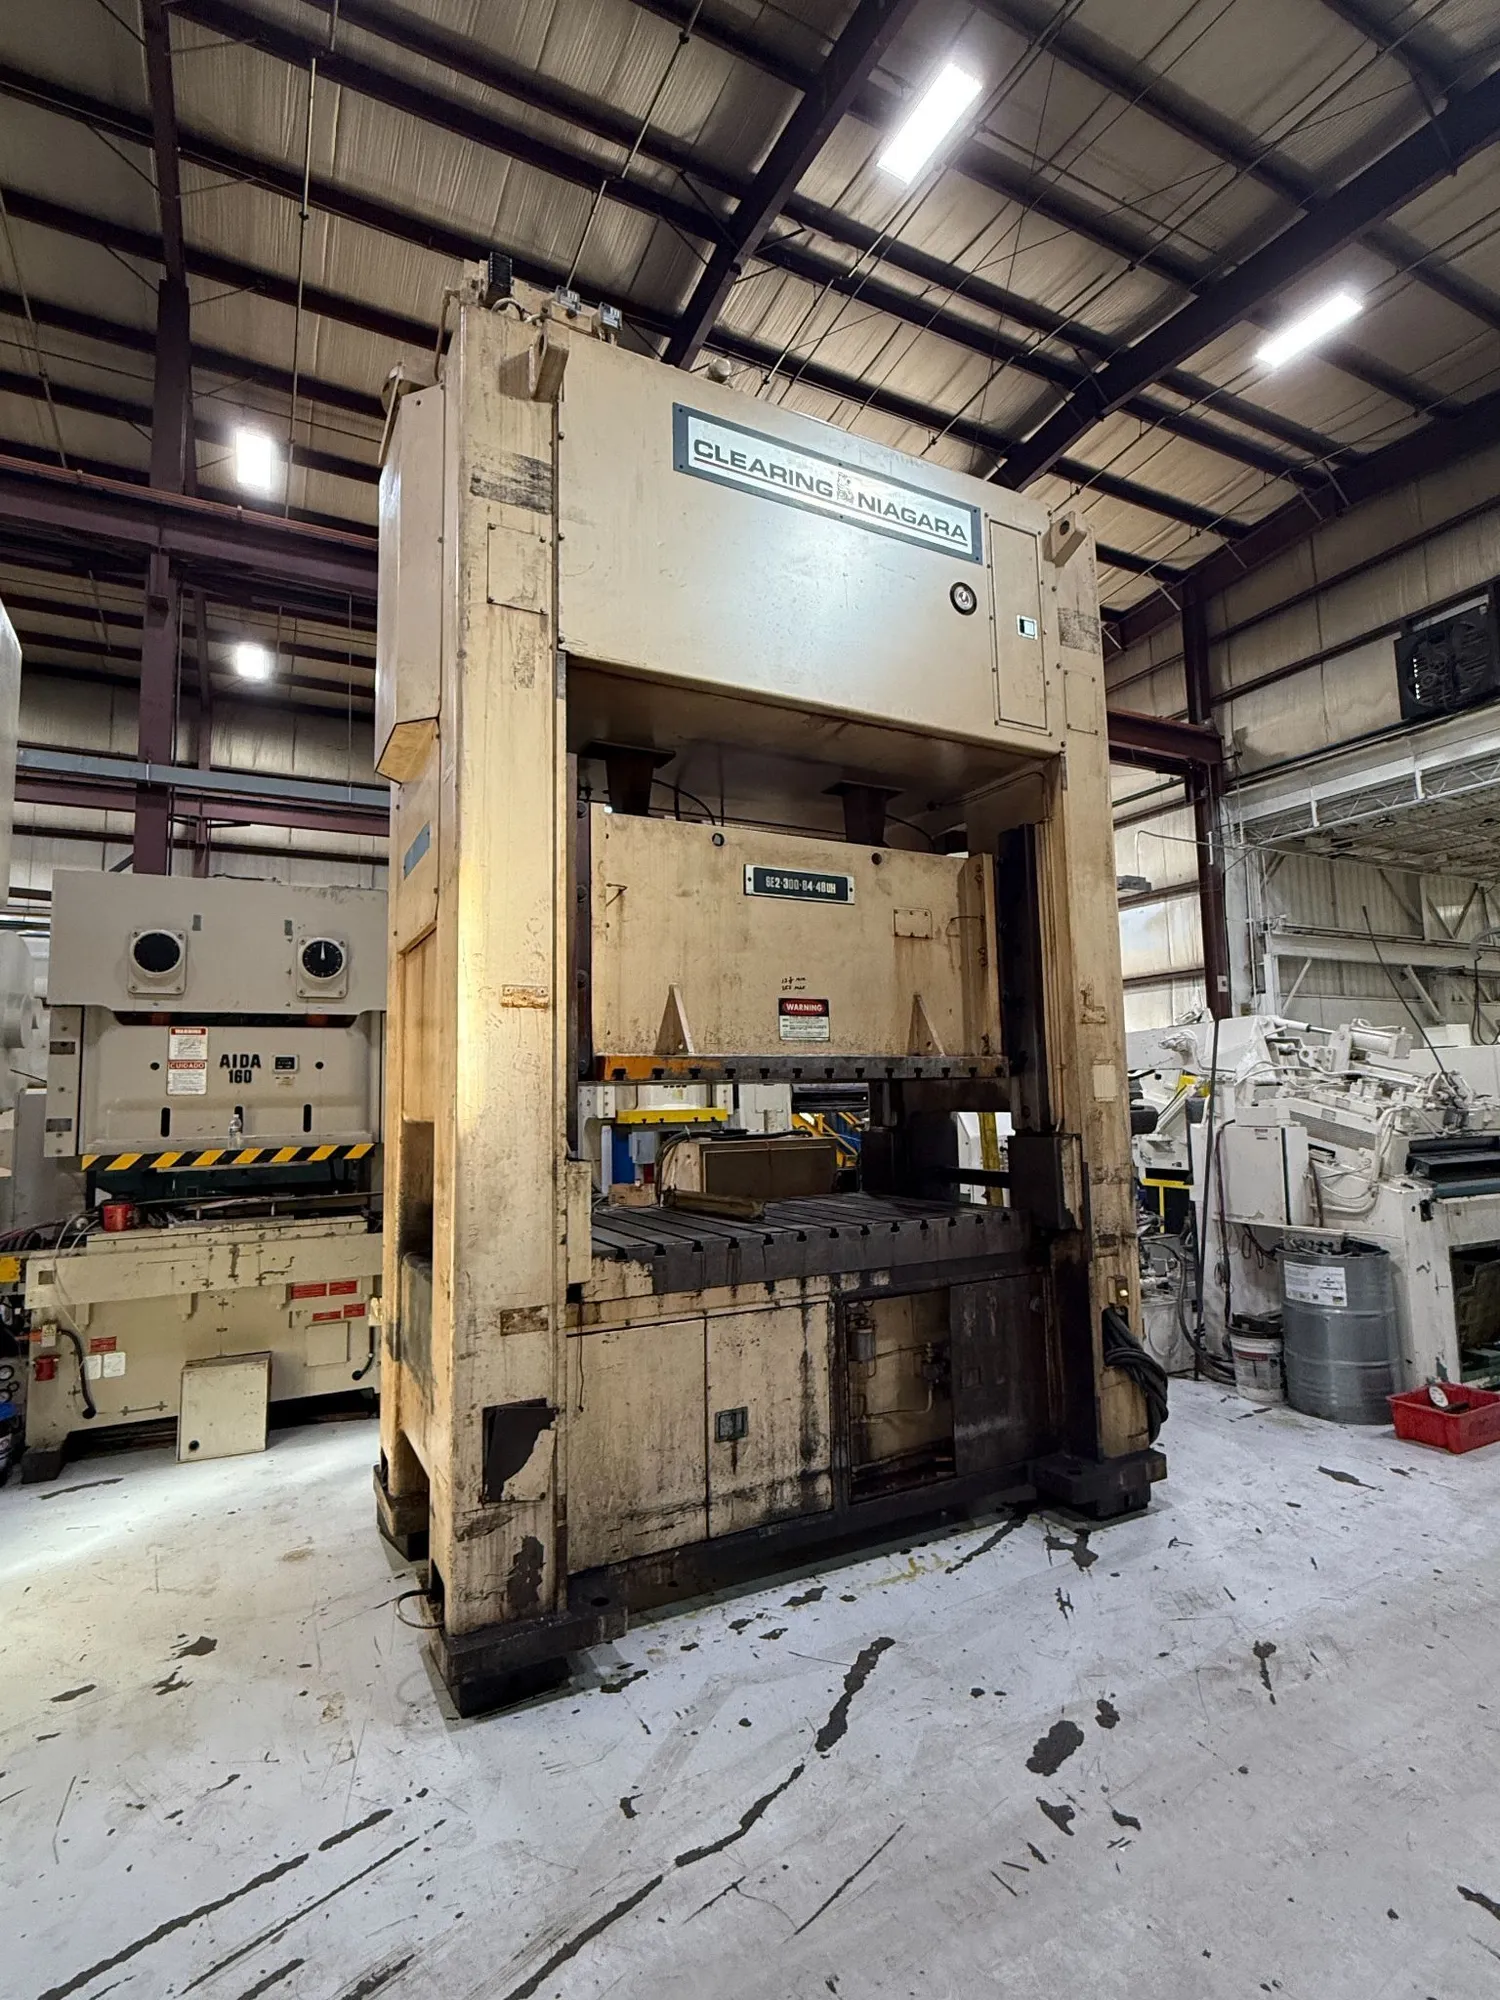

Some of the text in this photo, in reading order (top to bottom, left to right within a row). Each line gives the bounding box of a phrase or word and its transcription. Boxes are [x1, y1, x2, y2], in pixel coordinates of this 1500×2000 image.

[693, 438, 968, 541] CLEARING NIAGARA
[785, 1003, 823, 1012] WARNING
[170, 1061, 205, 1069] CUIDADO
[219, 1053, 262, 1069] AIDA
[228, 1069, 252, 1084] 160
